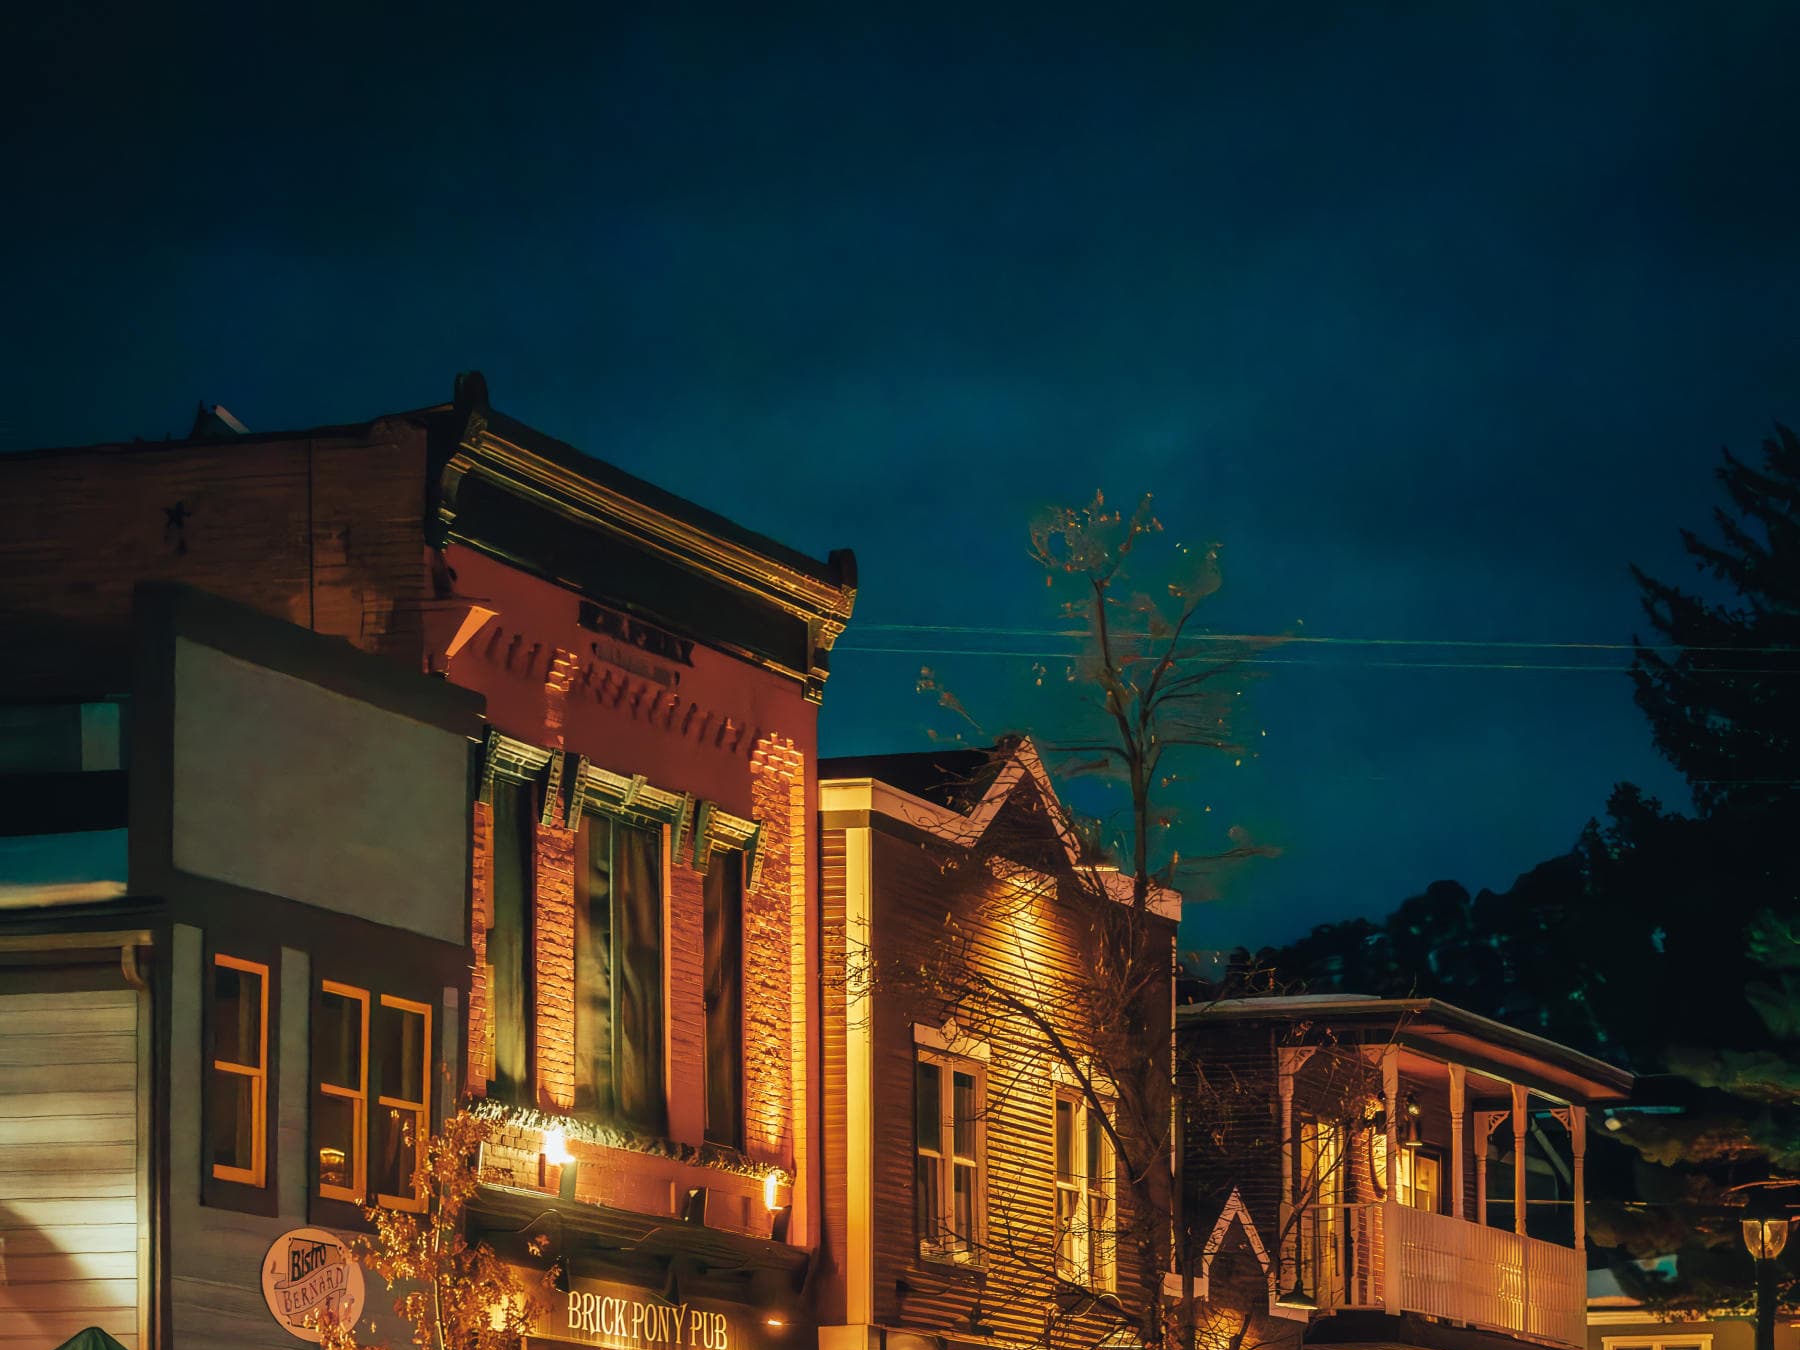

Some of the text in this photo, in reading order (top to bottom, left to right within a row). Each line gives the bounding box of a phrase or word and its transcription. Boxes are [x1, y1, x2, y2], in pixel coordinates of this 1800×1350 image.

[283, 1268, 344, 1312] BERNARD
[567, 1290, 728, 1350] BRICK PONY PUB
